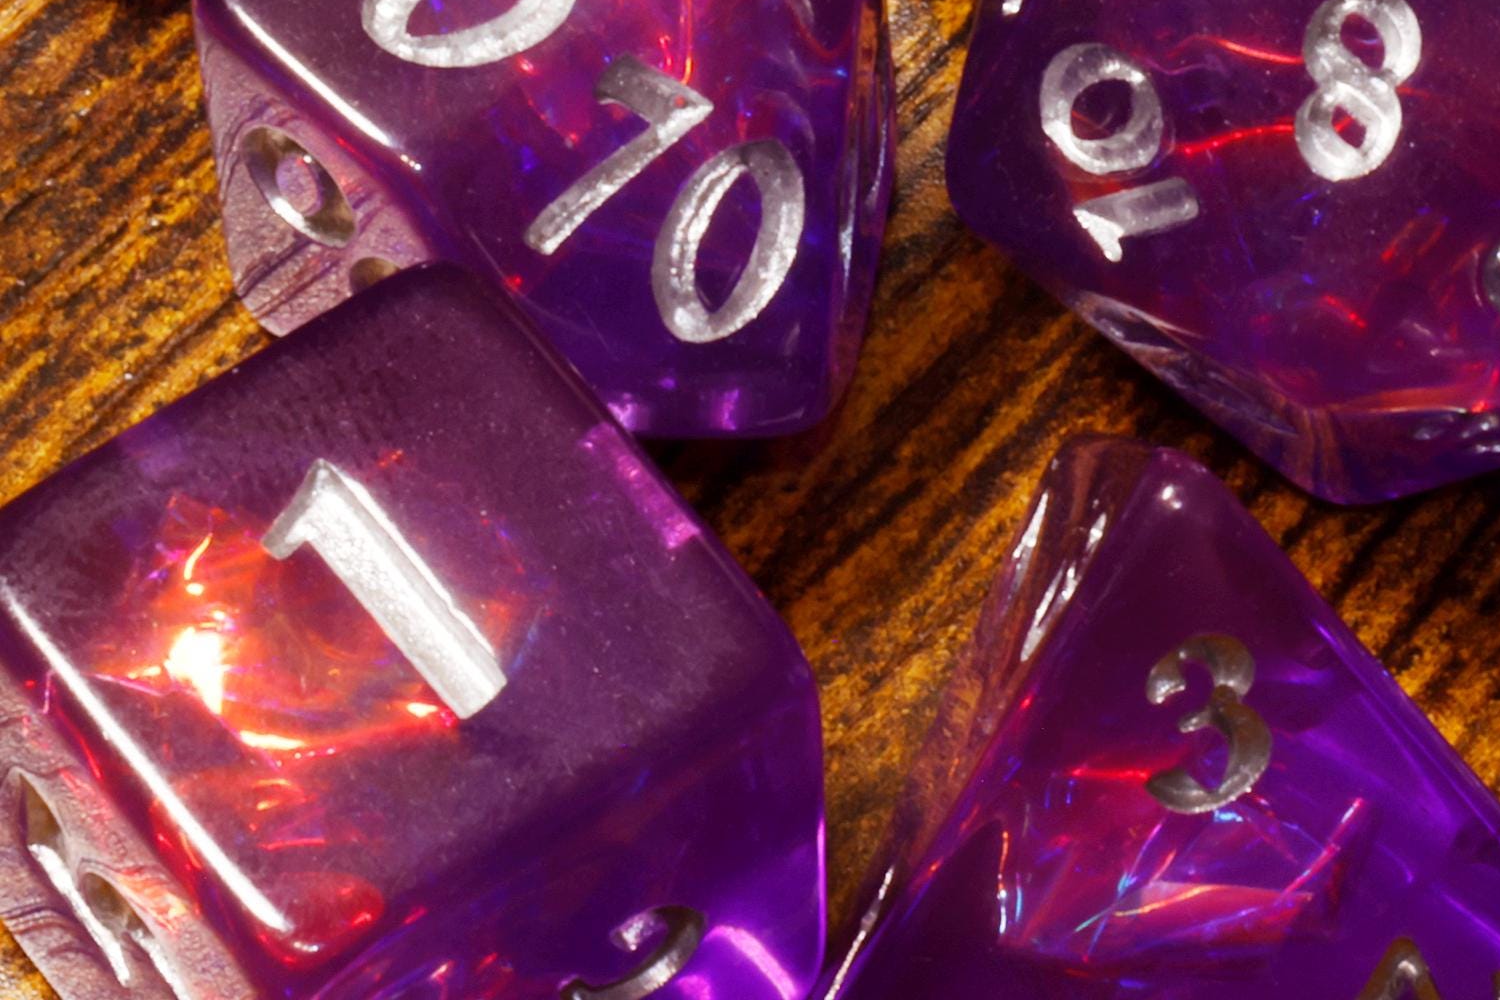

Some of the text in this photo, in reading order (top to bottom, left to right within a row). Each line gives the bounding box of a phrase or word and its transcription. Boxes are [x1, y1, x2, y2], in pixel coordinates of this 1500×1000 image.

[524, 52, 806, 343] 70
[1039, 41, 1200, 263] 10
[260, 457, 508, 720] 1
[1144, 632, 1273, 814] 3
